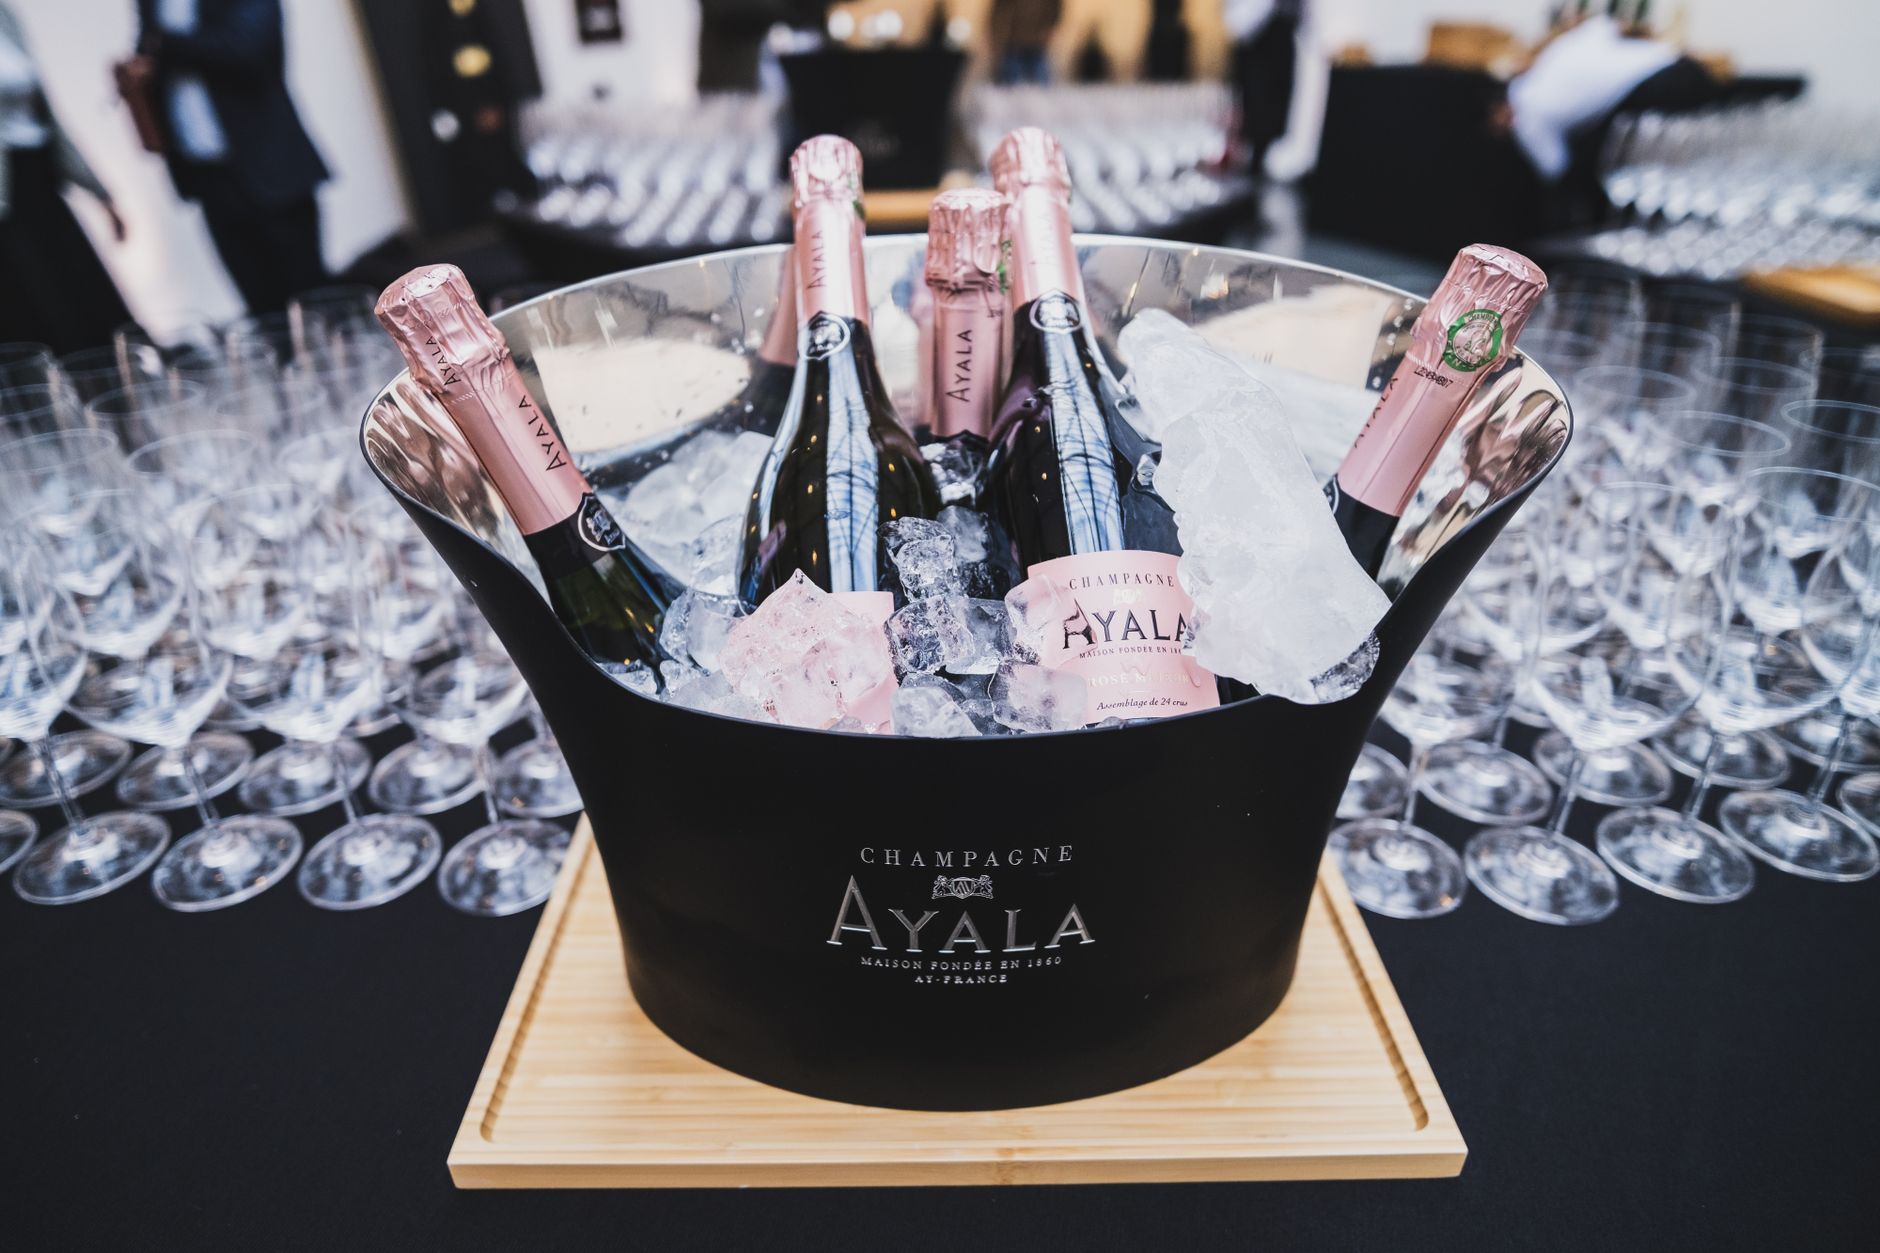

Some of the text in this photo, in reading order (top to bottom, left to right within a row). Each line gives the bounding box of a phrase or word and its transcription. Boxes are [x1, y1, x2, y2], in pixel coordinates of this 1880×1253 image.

[806, 229, 826, 291] AYALA
[425, 334, 462, 386] AYALA
[945, 327, 974, 403] AYALA
[517, 394, 568, 472] AYALA
[1068, 572, 1175, 591] CHAMPAGNE
[1079, 647, 1115, 660] MAISON
[1156, 645, 1168, 654] EN
[1096, 698, 1148, 711] Assemblage
[1149, 697, 1159, 707] de
[1160, 697, 1171, 706] 24
[860, 844, 1074, 868] CHAMPAGNE
[826, 874, 1096, 954] AYALA
[860, 956, 923, 970] MAISON
[1000, 959, 1020, 970] EN
[1027, 955, 1062, 968] 1860
[914, 974, 1008, 985] AY-FRANCE
